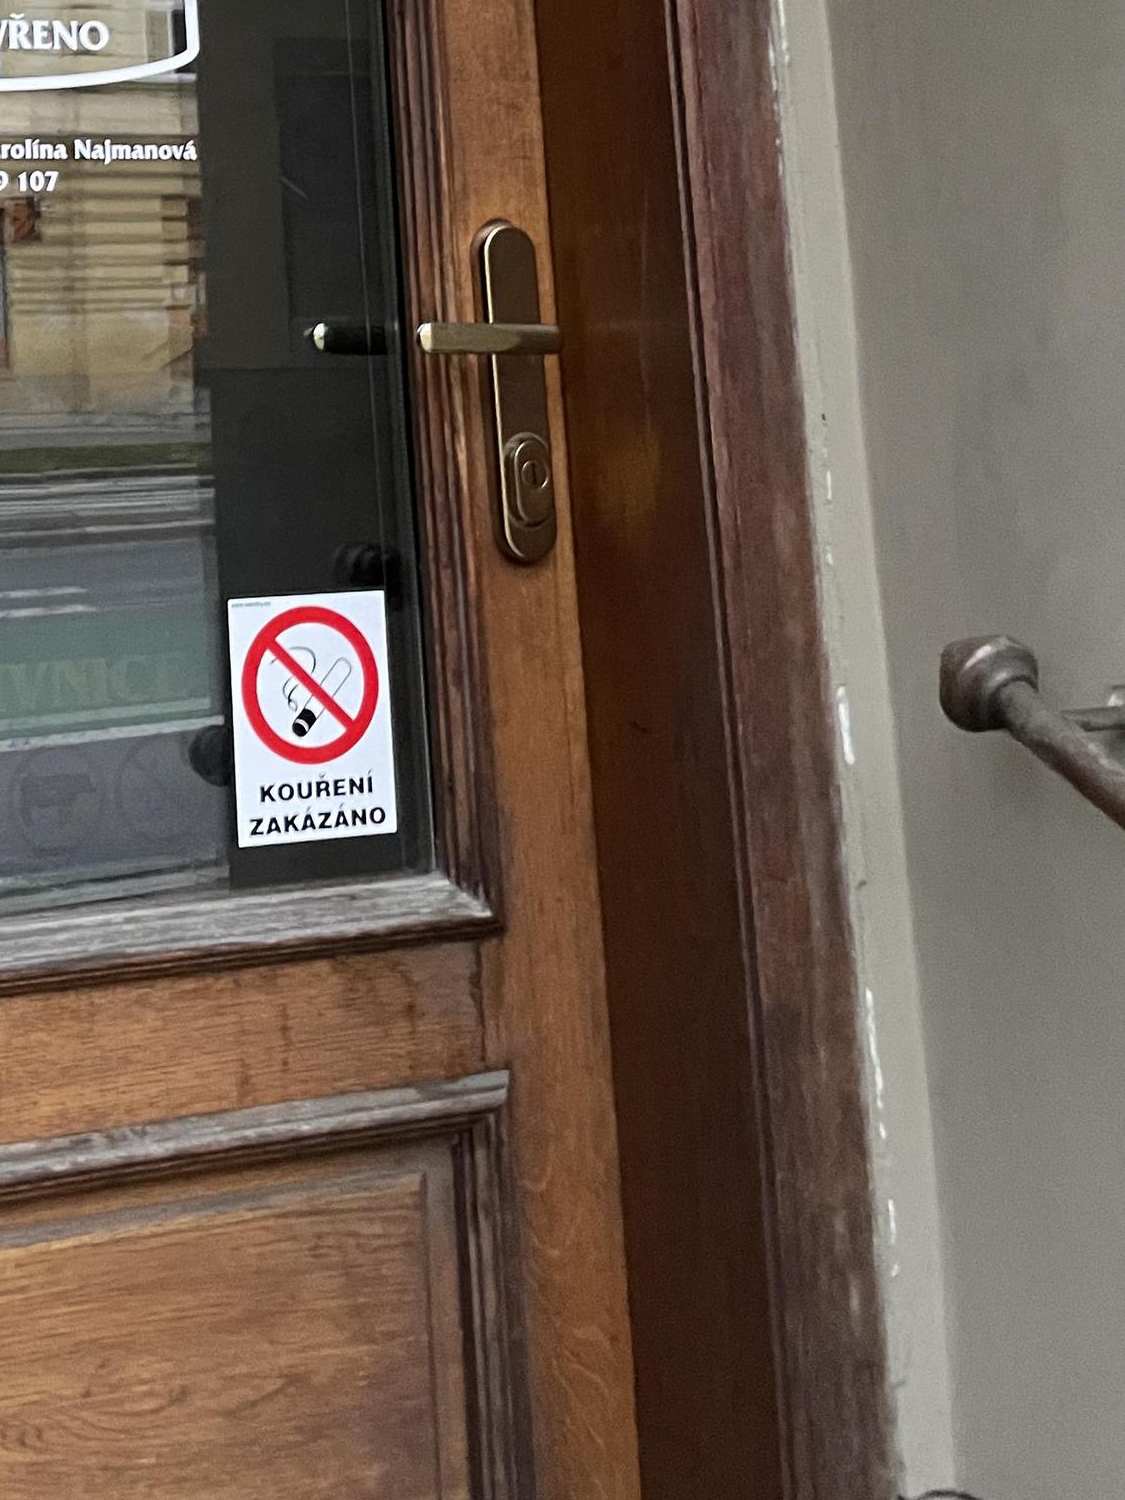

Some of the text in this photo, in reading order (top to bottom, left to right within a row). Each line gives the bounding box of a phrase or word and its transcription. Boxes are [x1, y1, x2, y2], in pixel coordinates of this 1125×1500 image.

[73, 140, 197, 164] Najmanová
[18, 171, 59, 192] 107
[260, 769, 373, 802] KOUŘENÍ
[250, 803, 386, 836] ZAKÁZÁNO
